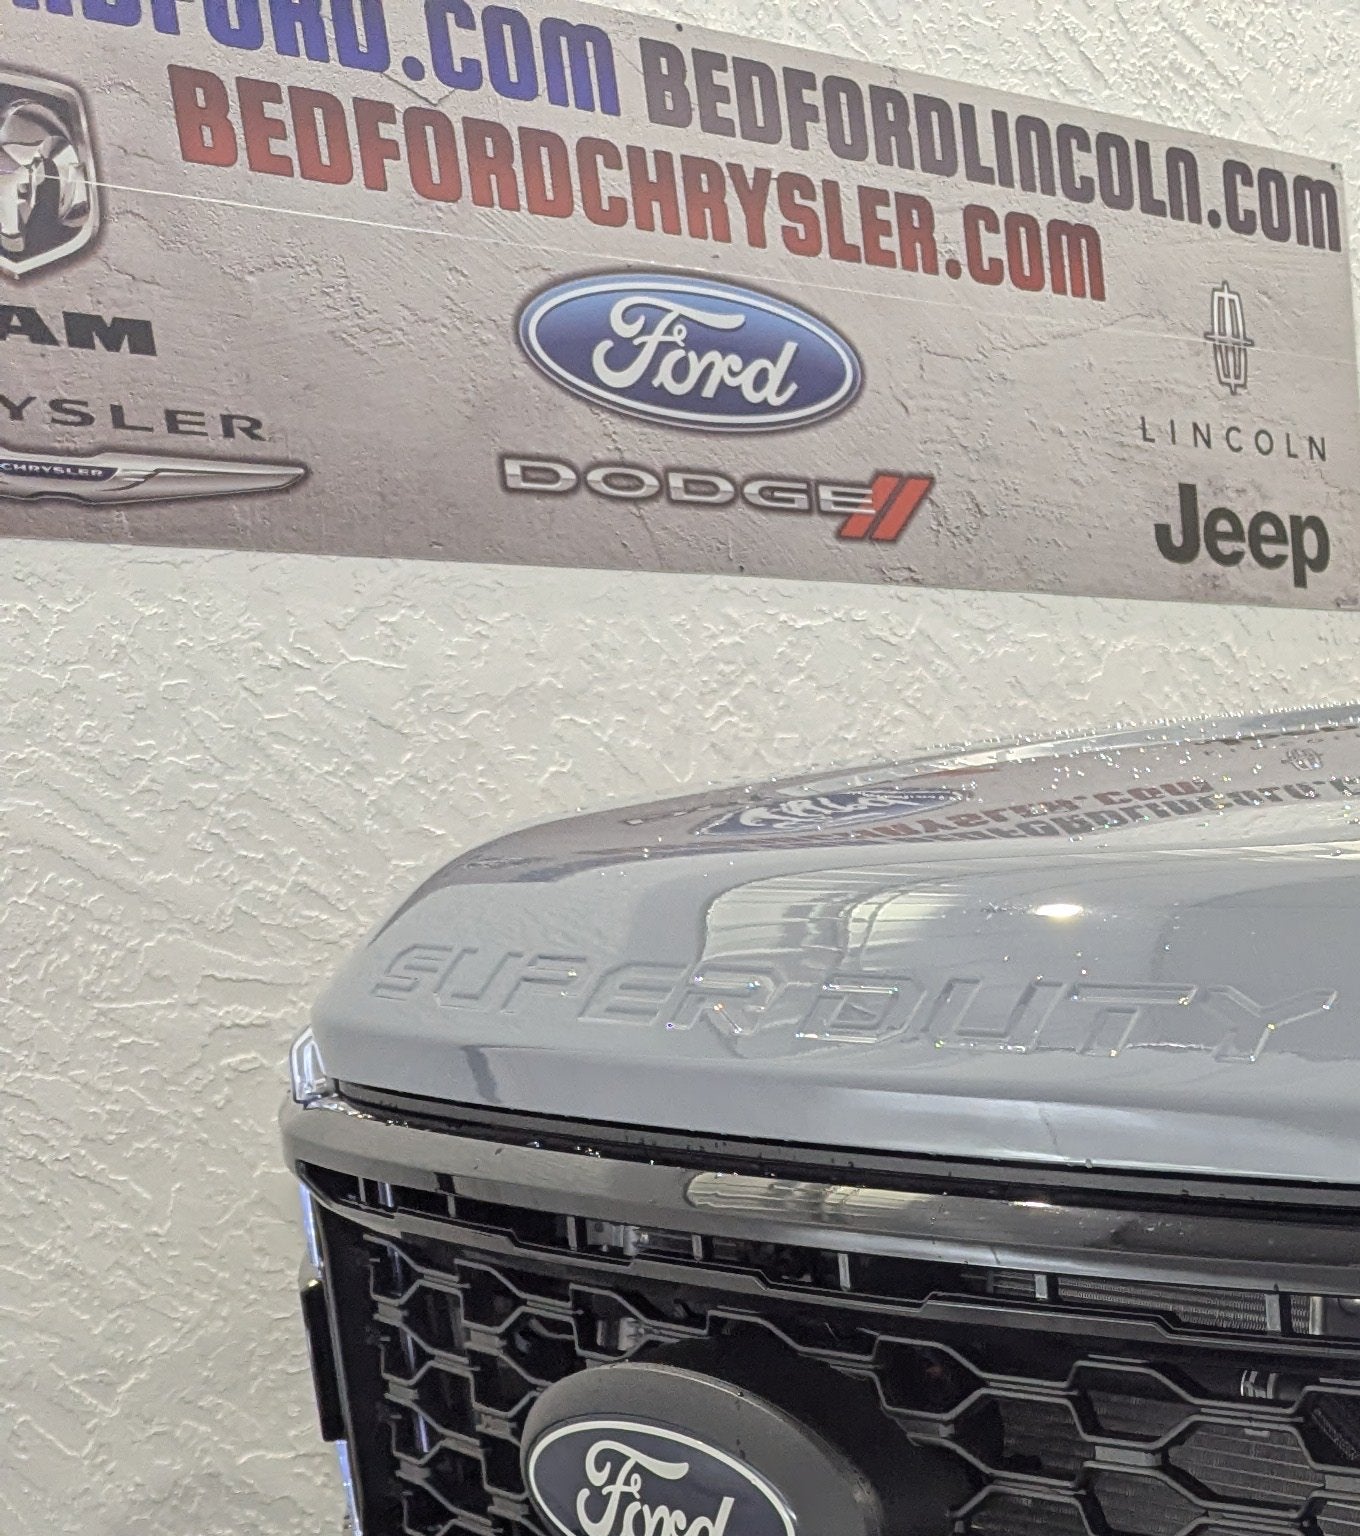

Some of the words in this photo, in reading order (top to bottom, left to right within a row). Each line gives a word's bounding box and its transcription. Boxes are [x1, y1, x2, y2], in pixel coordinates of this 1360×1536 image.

[167, 64, 1105, 301] BEDFORDCHRYSLER.COM
[640, 37, 1341, 252] BEDFORDLINCOLN.COM
[593, 296, 799, 406] Ford
[0, 462, 104, 476] CHRYSLER
[502, 457, 877, 515] DODGE
[1140, 416, 1327, 462] LINCOLN
[1153, 482, 1331, 589] Jeep
[371, 943, 780, 1036] SUPER
[796, 973, 1338, 1064] DUTY
